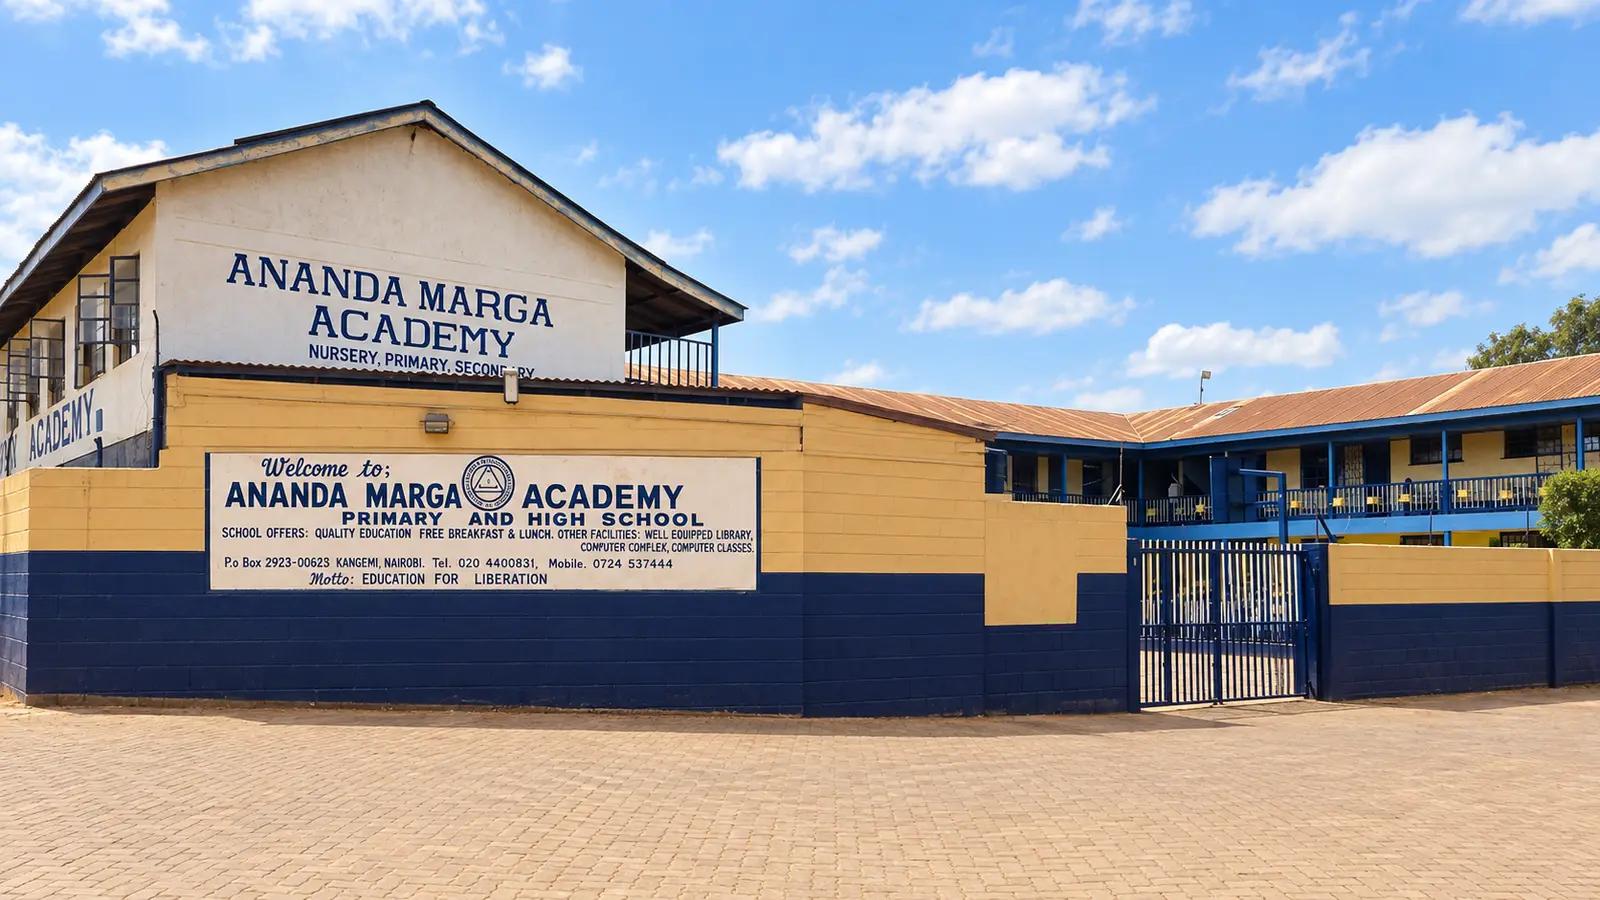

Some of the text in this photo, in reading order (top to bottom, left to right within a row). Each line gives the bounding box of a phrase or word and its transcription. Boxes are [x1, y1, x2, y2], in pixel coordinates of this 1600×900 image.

[226, 252, 554, 328] ANANDA MARGA
[308, 304, 516, 358] ACADEMY
[309, 343, 535, 378] NURSERY, PRIMARY, SECONRY
[29, 388, 94, 461] ACADEMY
[261, 456, 349, 478] Welcome
[225, 481, 348, 508] ANANDA
[365, 482, 463, 509] MARGA
[521, 483, 684, 510] ACADEMY
[342, 511, 704, 527] PRIMARY AND HIGH SCHOOL
[222, 527, 262, 539] SCHOOL
[266, 527, 308, 539] OFFERS:
[315, 527, 355, 540] QUALITY
[360, 527, 412, 539] EDUCATION
[419, 528, 445, 539] FREE
[448, 528, 504, 540] BREAKFAST
[508, 528, 515, 539] &
[519, 528, 554, 540] LUNCH.
[558, 529, 588, 540] OTHER
[590, 529, 640, 540] FACILITIES:
[645, 529, 669, 540] WELL
[716, 529, 754, 542] LIBRARY,
[671, 542, 714, 553] COMPUTER
[717, 542, 754, 553] CLASSES.
[243, 556, 262, 568] Box
[336, 557, 381, 570] KANGEMI,
[384, 557, 425, 569] NAIROBI.
[432, 557, 452, 569] Tel.
[458, 557, 480, 569] 020
[486, 557, 538, 570] 4400831,
[548, 557, 587, 569] Mobile.
[592, 558, 623, 569] 0724
[628, 558, 673, 569] 537444
[309, 571, 548, 586] Motto: EDUCATION FOR LIBERATION
